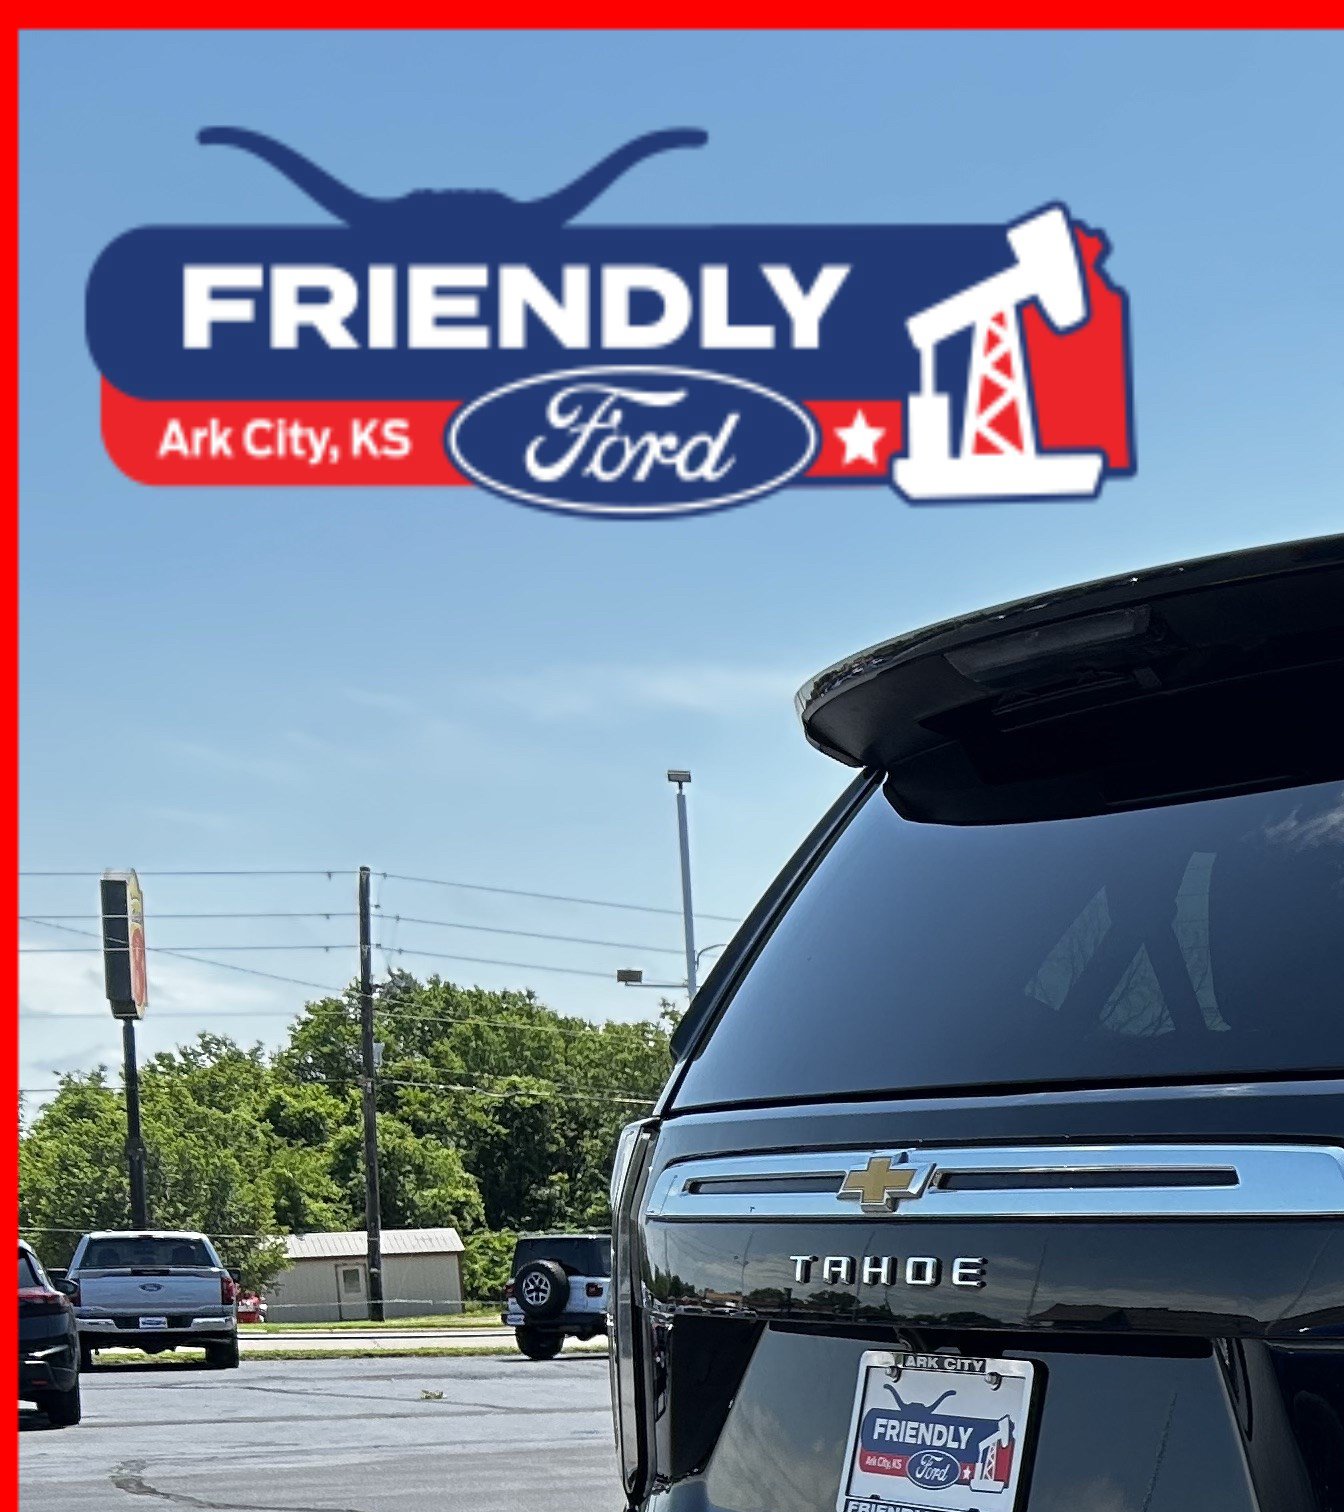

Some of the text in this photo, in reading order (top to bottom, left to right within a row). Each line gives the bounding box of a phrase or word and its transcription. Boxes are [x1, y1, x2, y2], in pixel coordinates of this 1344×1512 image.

[789, 1255, 988, 1286] TAHOE
[905, 1355, 984, 1372] ARK CITY
[873, 1418, 974, 1450] FRIENDLY
[915, 1453, 951, 1482] Ford
